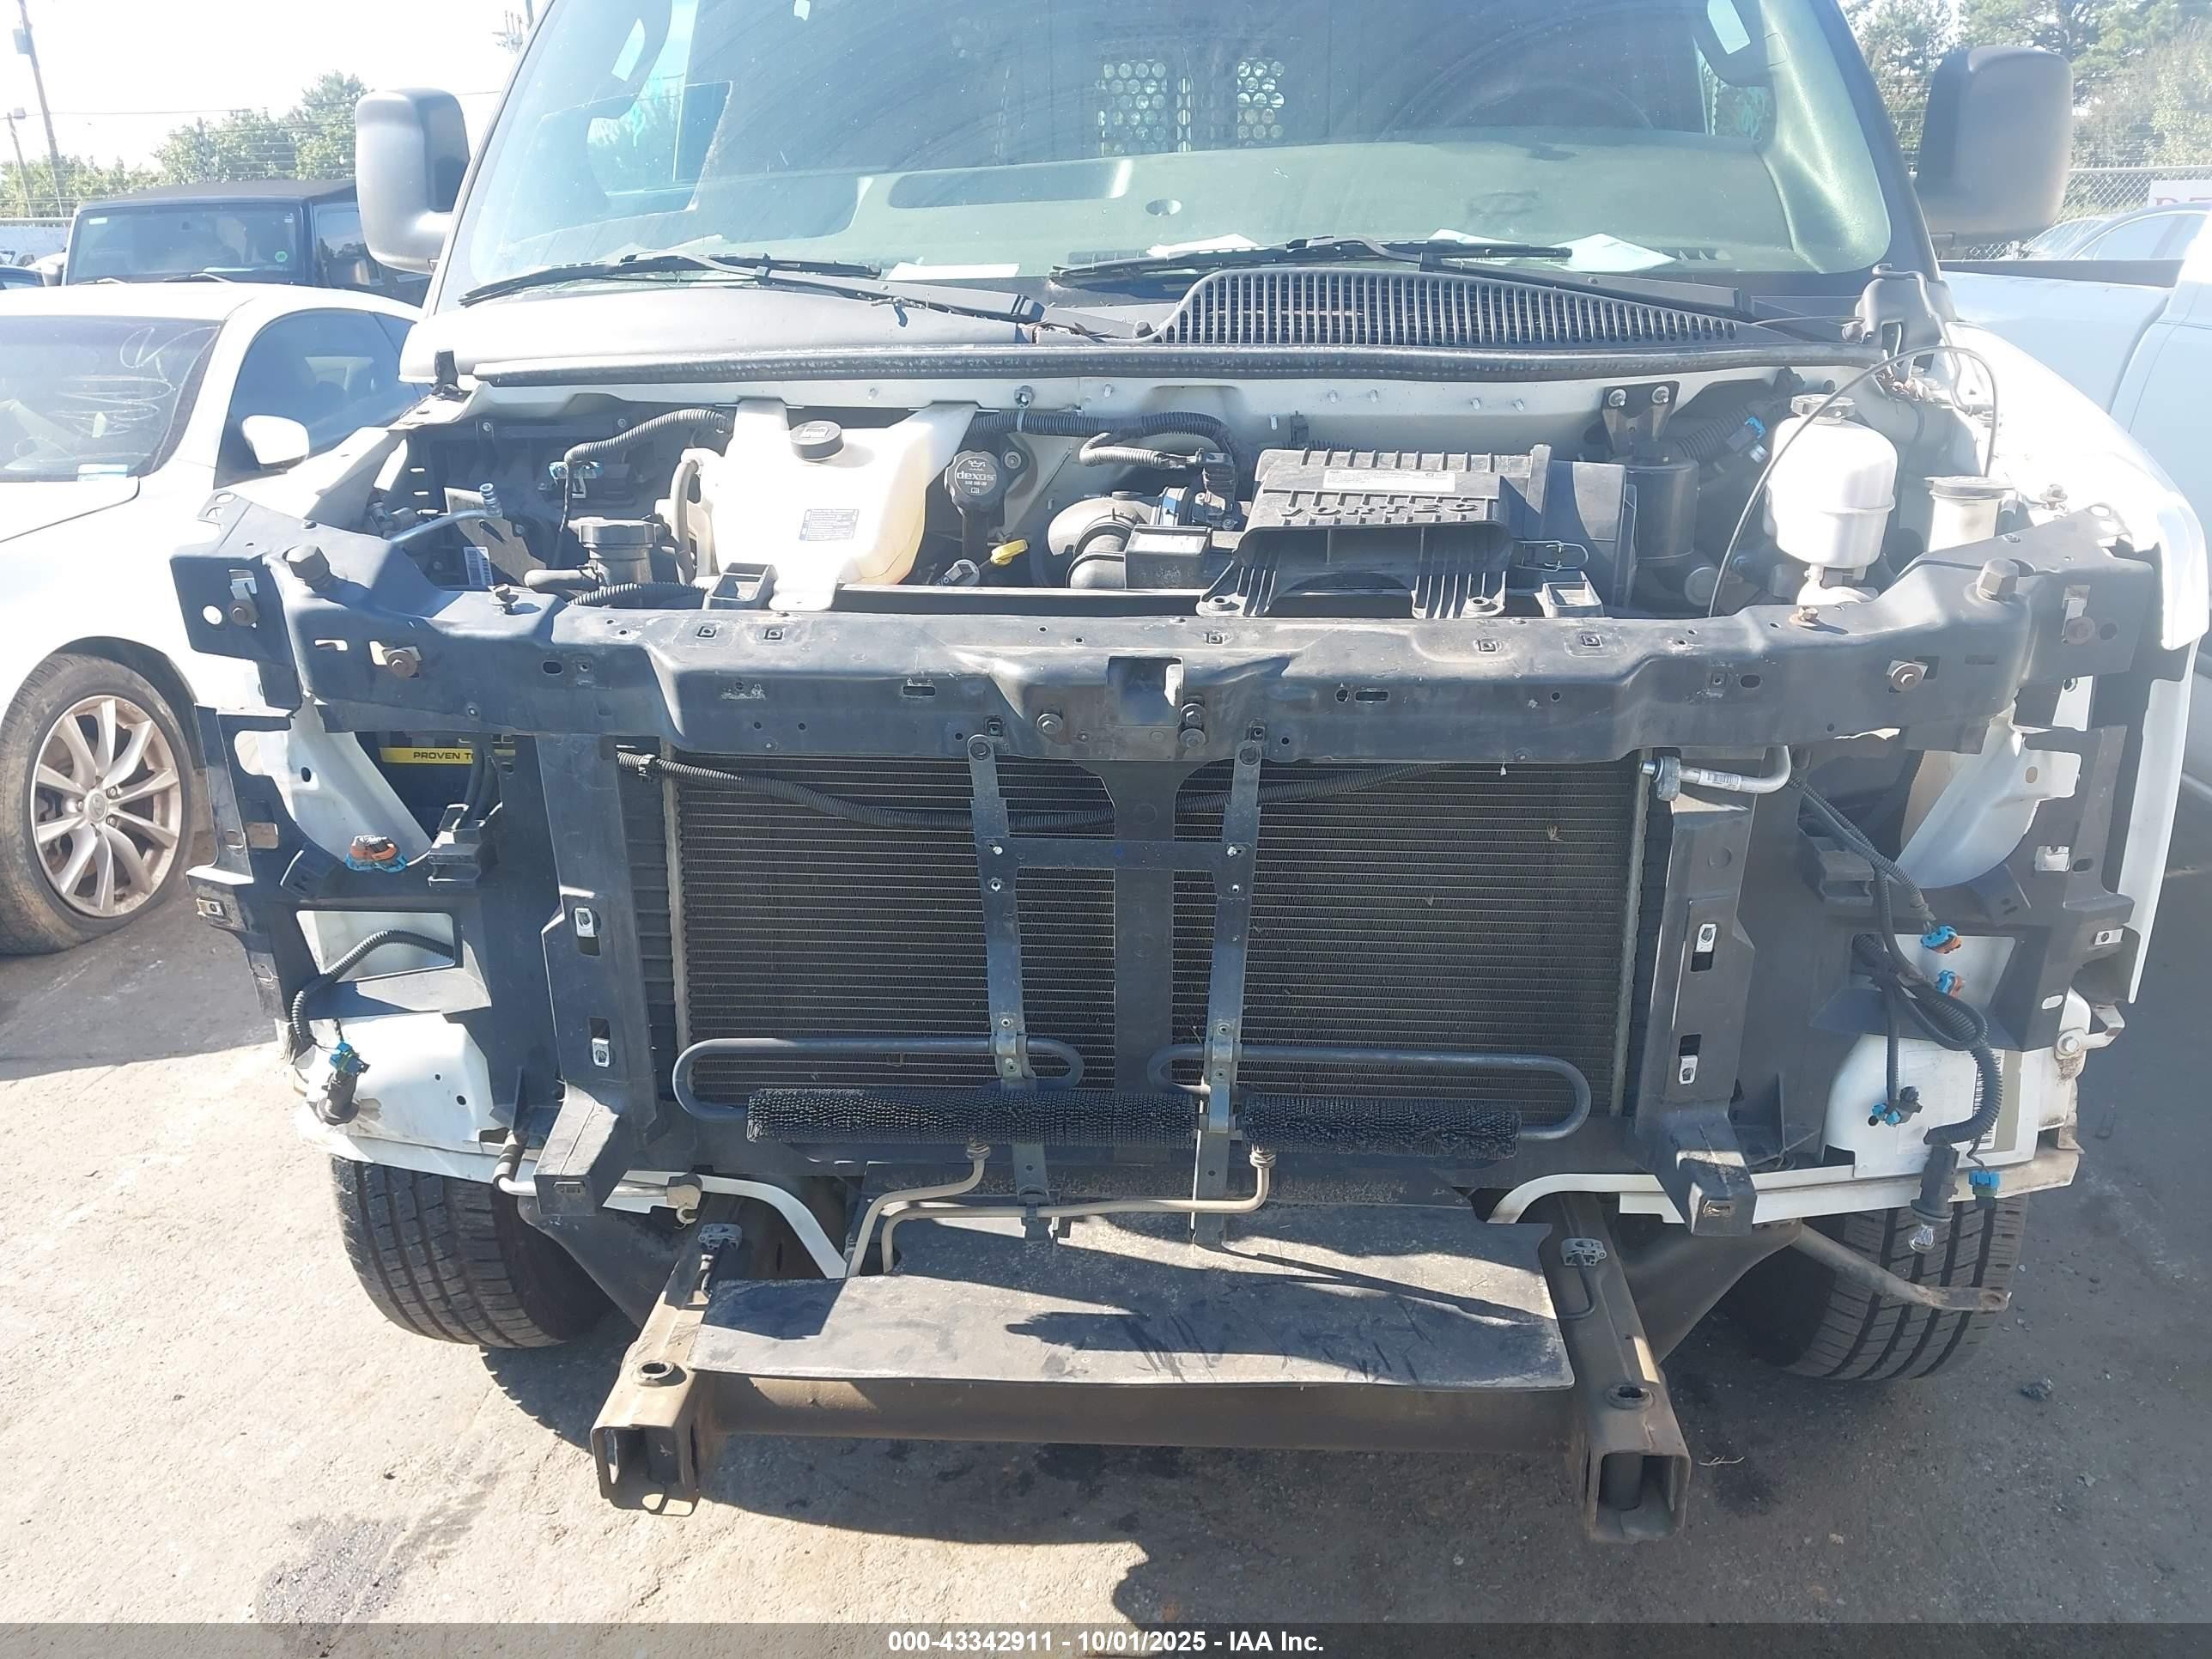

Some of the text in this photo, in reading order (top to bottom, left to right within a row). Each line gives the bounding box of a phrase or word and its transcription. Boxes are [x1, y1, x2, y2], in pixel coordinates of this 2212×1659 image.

[956, 470, 996, 481] dexos
[1279, 502, 1479, 517] VORTEC
[413, 751, 460, 760] PROVEN
